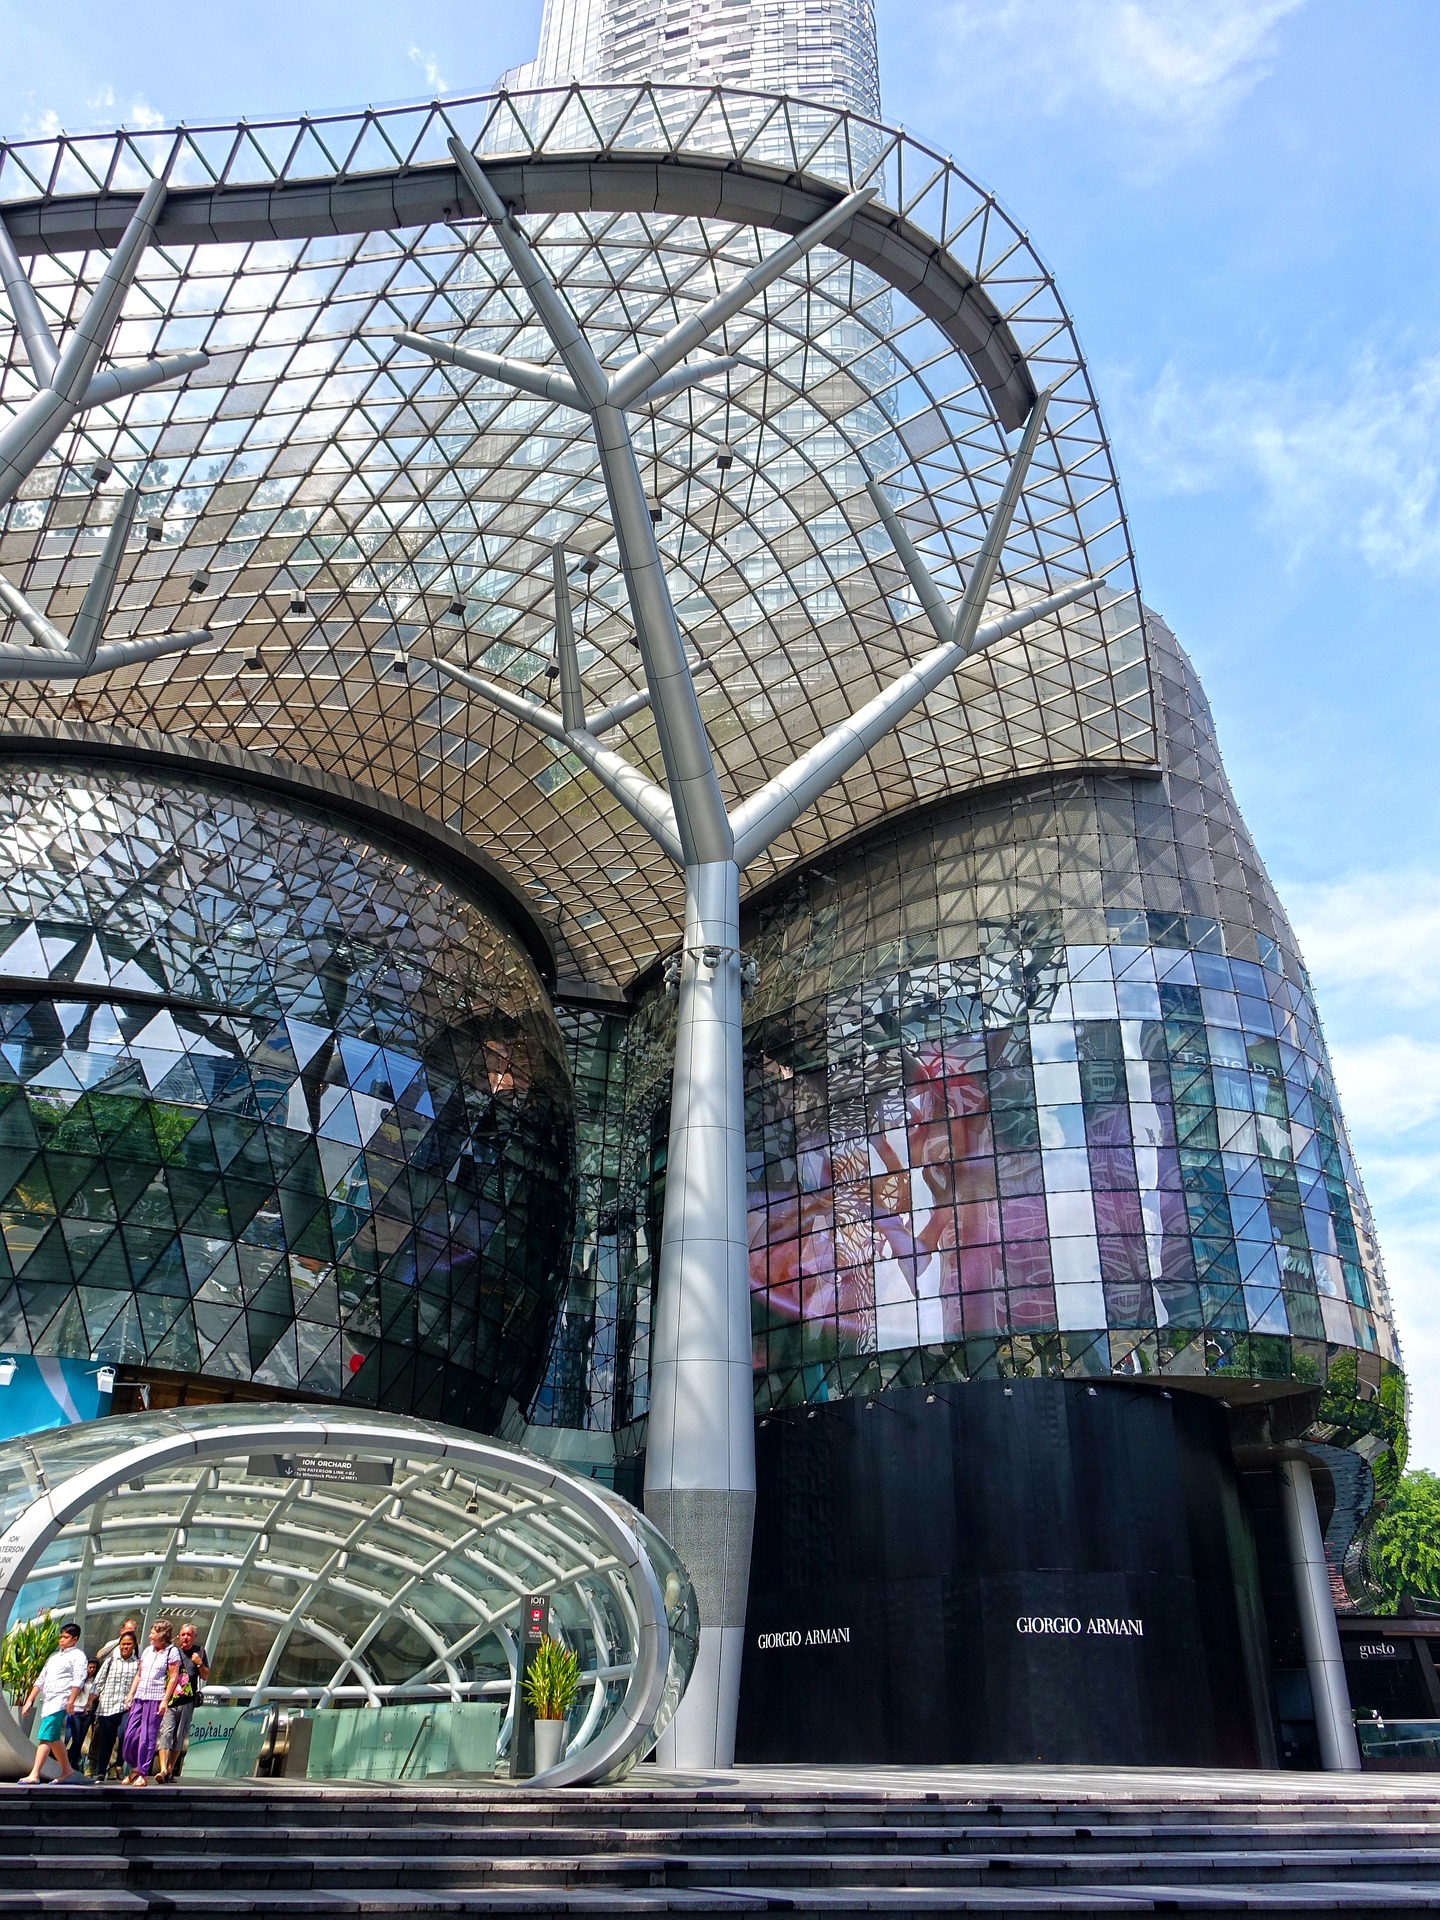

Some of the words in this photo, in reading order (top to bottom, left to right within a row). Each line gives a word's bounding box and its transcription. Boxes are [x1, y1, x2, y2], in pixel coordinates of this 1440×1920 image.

[302, 1459, 316, 1467] ION
[317, 1460, 352, 1469] ORCHARD
[8, 1535, 20, 1543] ION
[1016, 1616, 1081, 1634] GIORGIO
[1086, 1618, 1144, 1636] ARMANI
[758, 1630, 802, 1649] GIORGIO
[804, 1627, 850, 1645] ARMANI
[1359, 1642, 1395, 1660] gusto
[189, 1721, 235, 1741] CapitaLan
